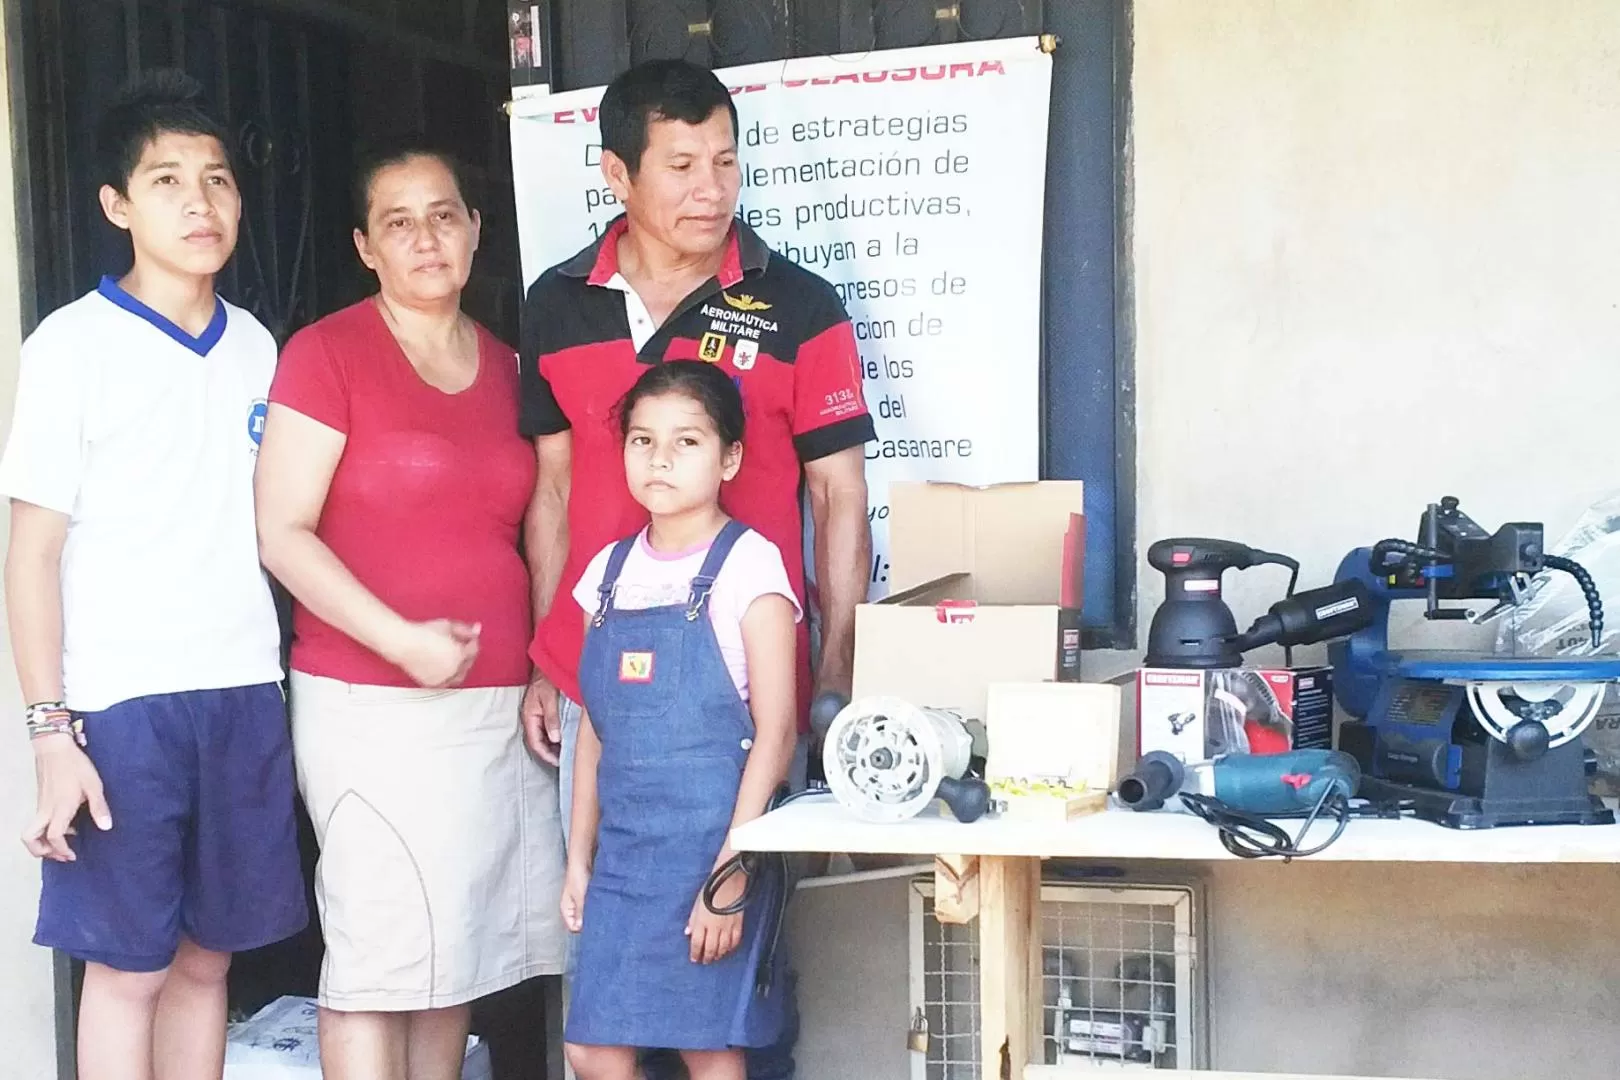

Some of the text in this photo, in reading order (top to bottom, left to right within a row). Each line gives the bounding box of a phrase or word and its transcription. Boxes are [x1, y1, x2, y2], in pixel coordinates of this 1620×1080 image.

[746, 110, 968, 147] de estrategias
[740, 149, 969, 188] lementación de
[795, 191, 971, 231] productivas,
[866, 239, 881, 258] a
[895, 231, 918, 256] la
[834, 271, 967, 307] gresos de
[700, 304, 778, 332] AERONAUTICA
[710, 320, 761, 339] MILITARE
[850, 311, 943, 341] cion de
[883, 353, 914, 379] los
[878, 393, 908, 419] del
[865, 437, 973, 460] Casanare
